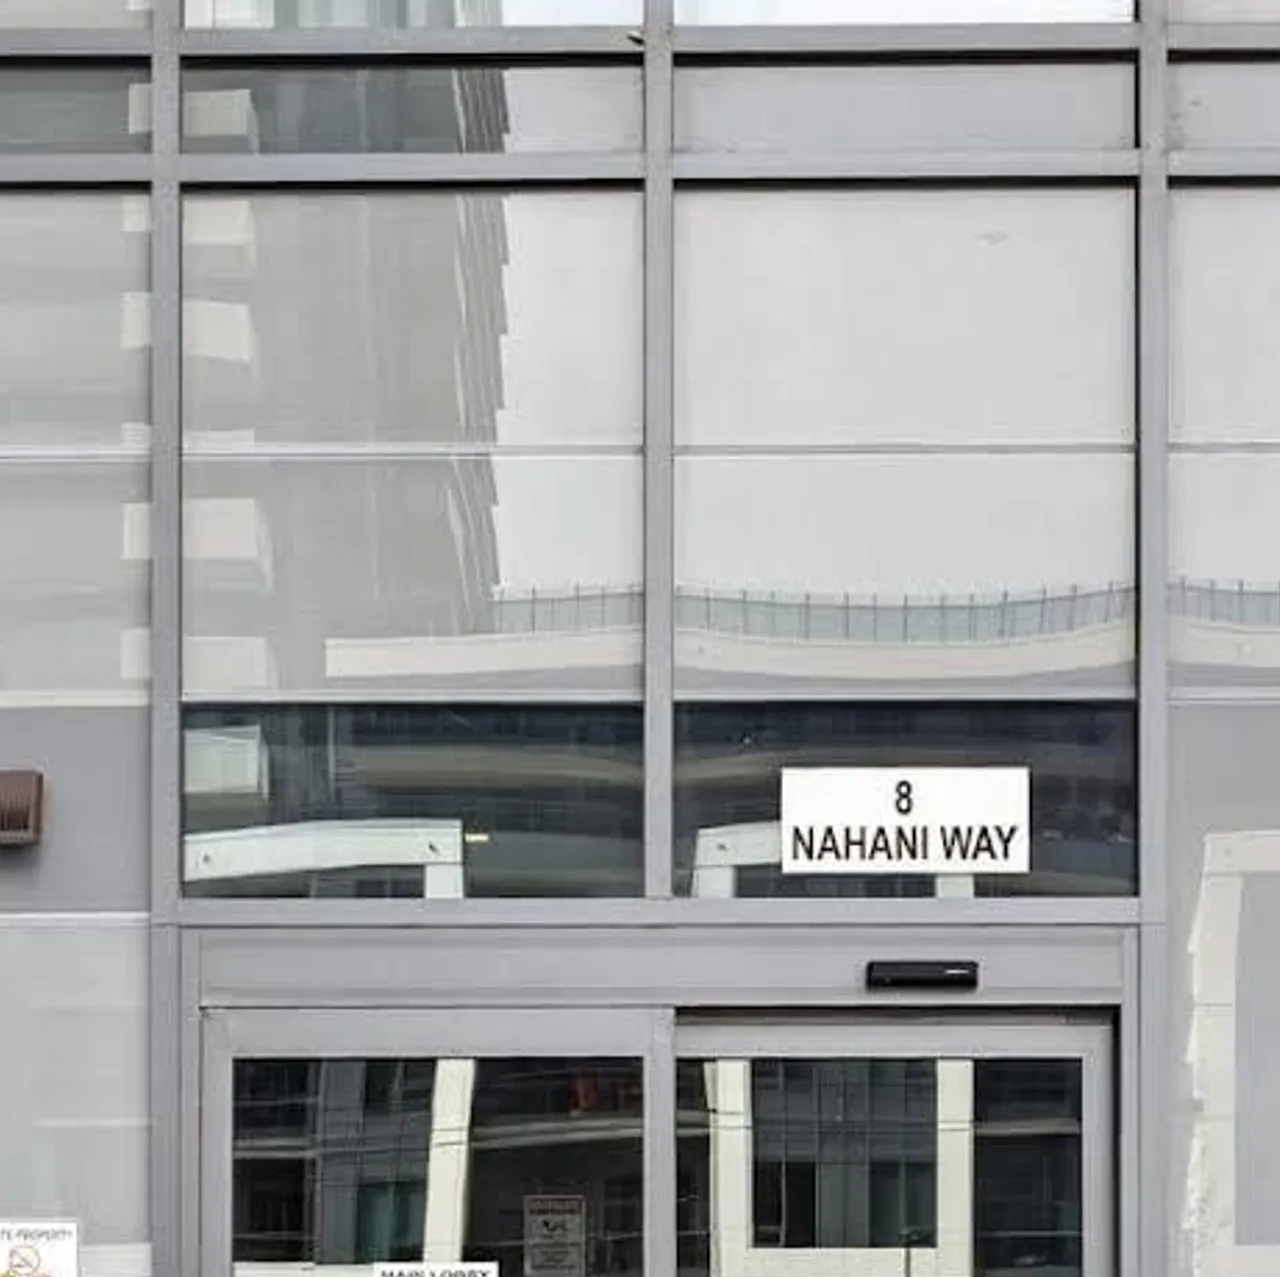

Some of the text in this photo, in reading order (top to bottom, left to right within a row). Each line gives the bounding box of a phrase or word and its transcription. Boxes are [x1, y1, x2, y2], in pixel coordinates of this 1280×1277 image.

[894, 779, 914, 816] 8
[792, 825, 1018, 861] NAHANI WAY
